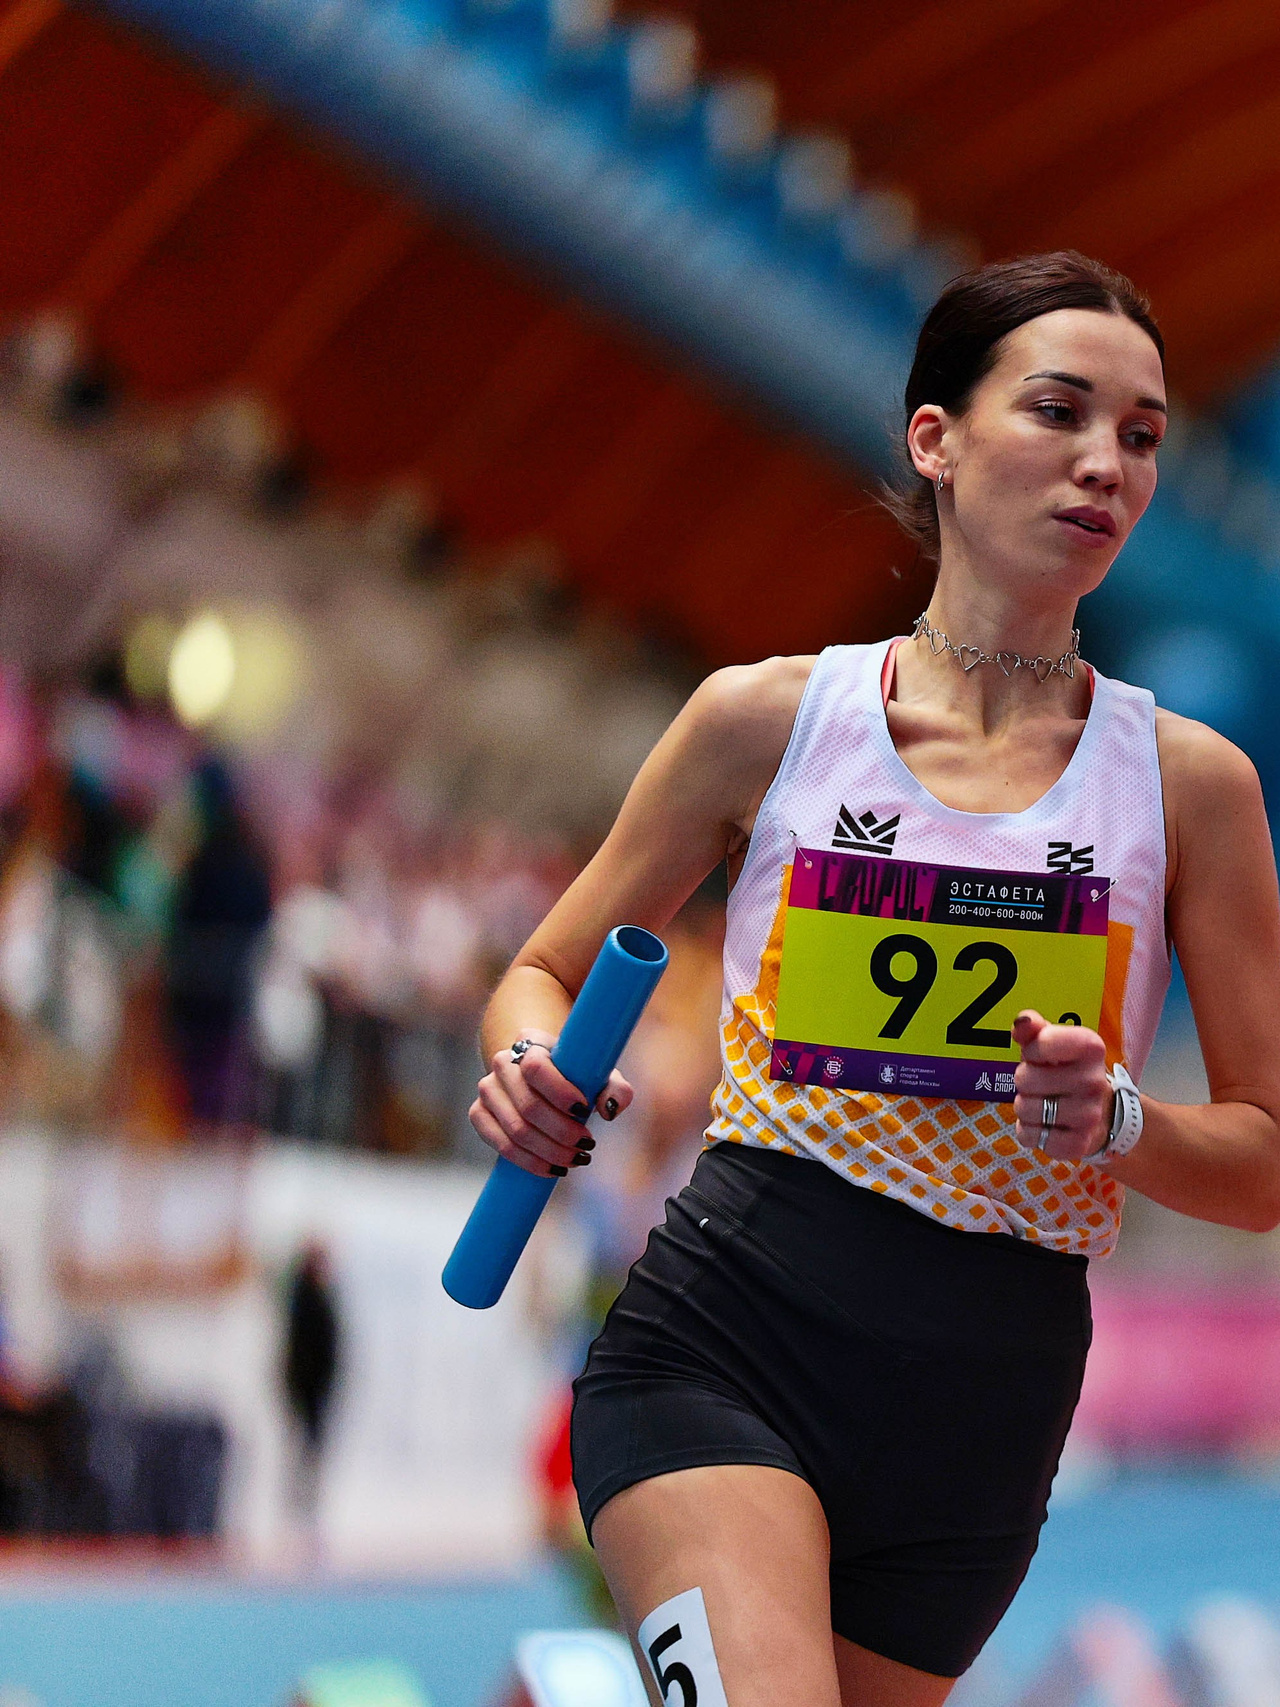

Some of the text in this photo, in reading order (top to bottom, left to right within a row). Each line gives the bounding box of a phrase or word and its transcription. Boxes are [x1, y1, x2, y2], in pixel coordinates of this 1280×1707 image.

[950, 881, 1045, 902] ЭСТАФЕТА
[869, 933, 1018, 1049] 92
[900, 1066, 935, 1074] Департамент
[995, 1073, 1015, 1083] МОСК
[648, 1622, 698, 1707] 5
